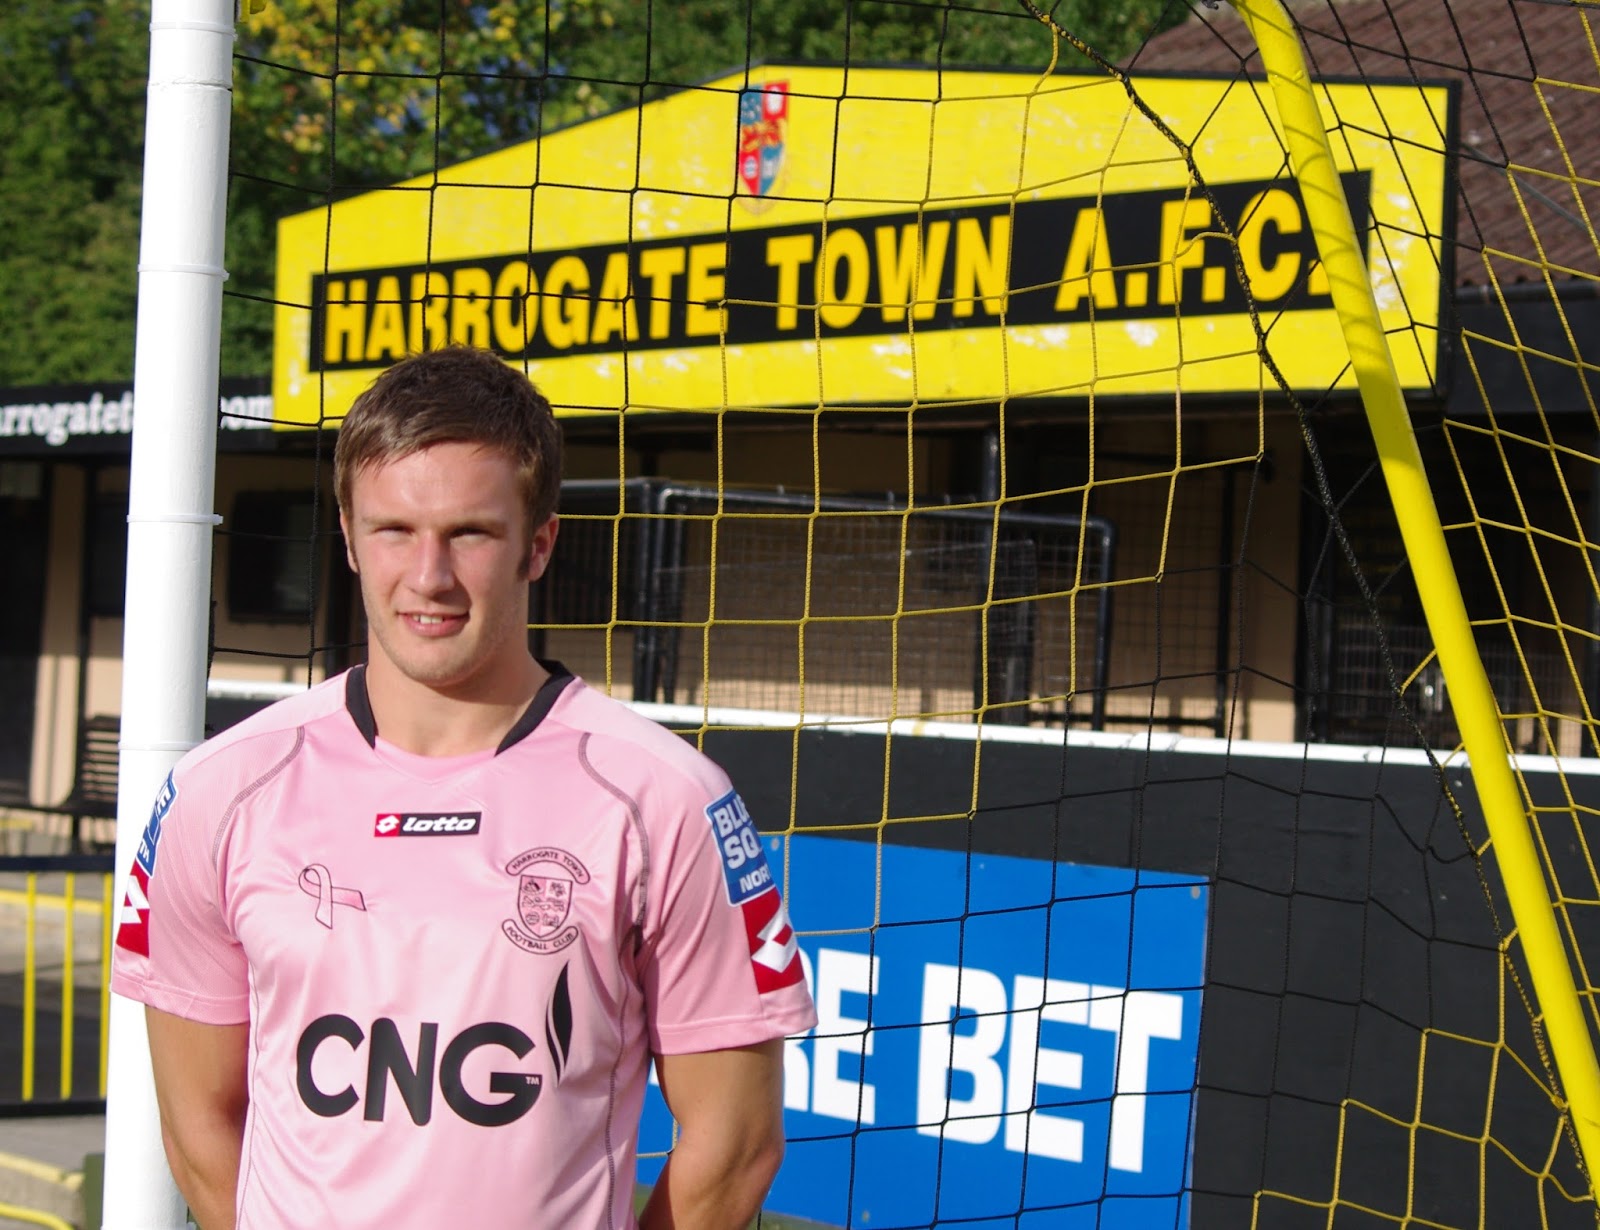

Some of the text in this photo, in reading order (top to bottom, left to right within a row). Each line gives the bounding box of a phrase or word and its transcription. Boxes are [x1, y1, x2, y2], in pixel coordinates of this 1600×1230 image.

[324, 188, 1332, 364] HARROGATE TOWN A.F.C.
[0, 390, 134, 446] rrogatet
[402, 816, 476, 832] lotto
[723, 826, 763, 870] SQ
[511, 850, 584, 878] HARROGATE TOWN
[506, 926, 574, 950] FOOTBALL CLUB
[296, 1013, 543, 1127] CNG
[916, 962, 1183, 1173] BET
